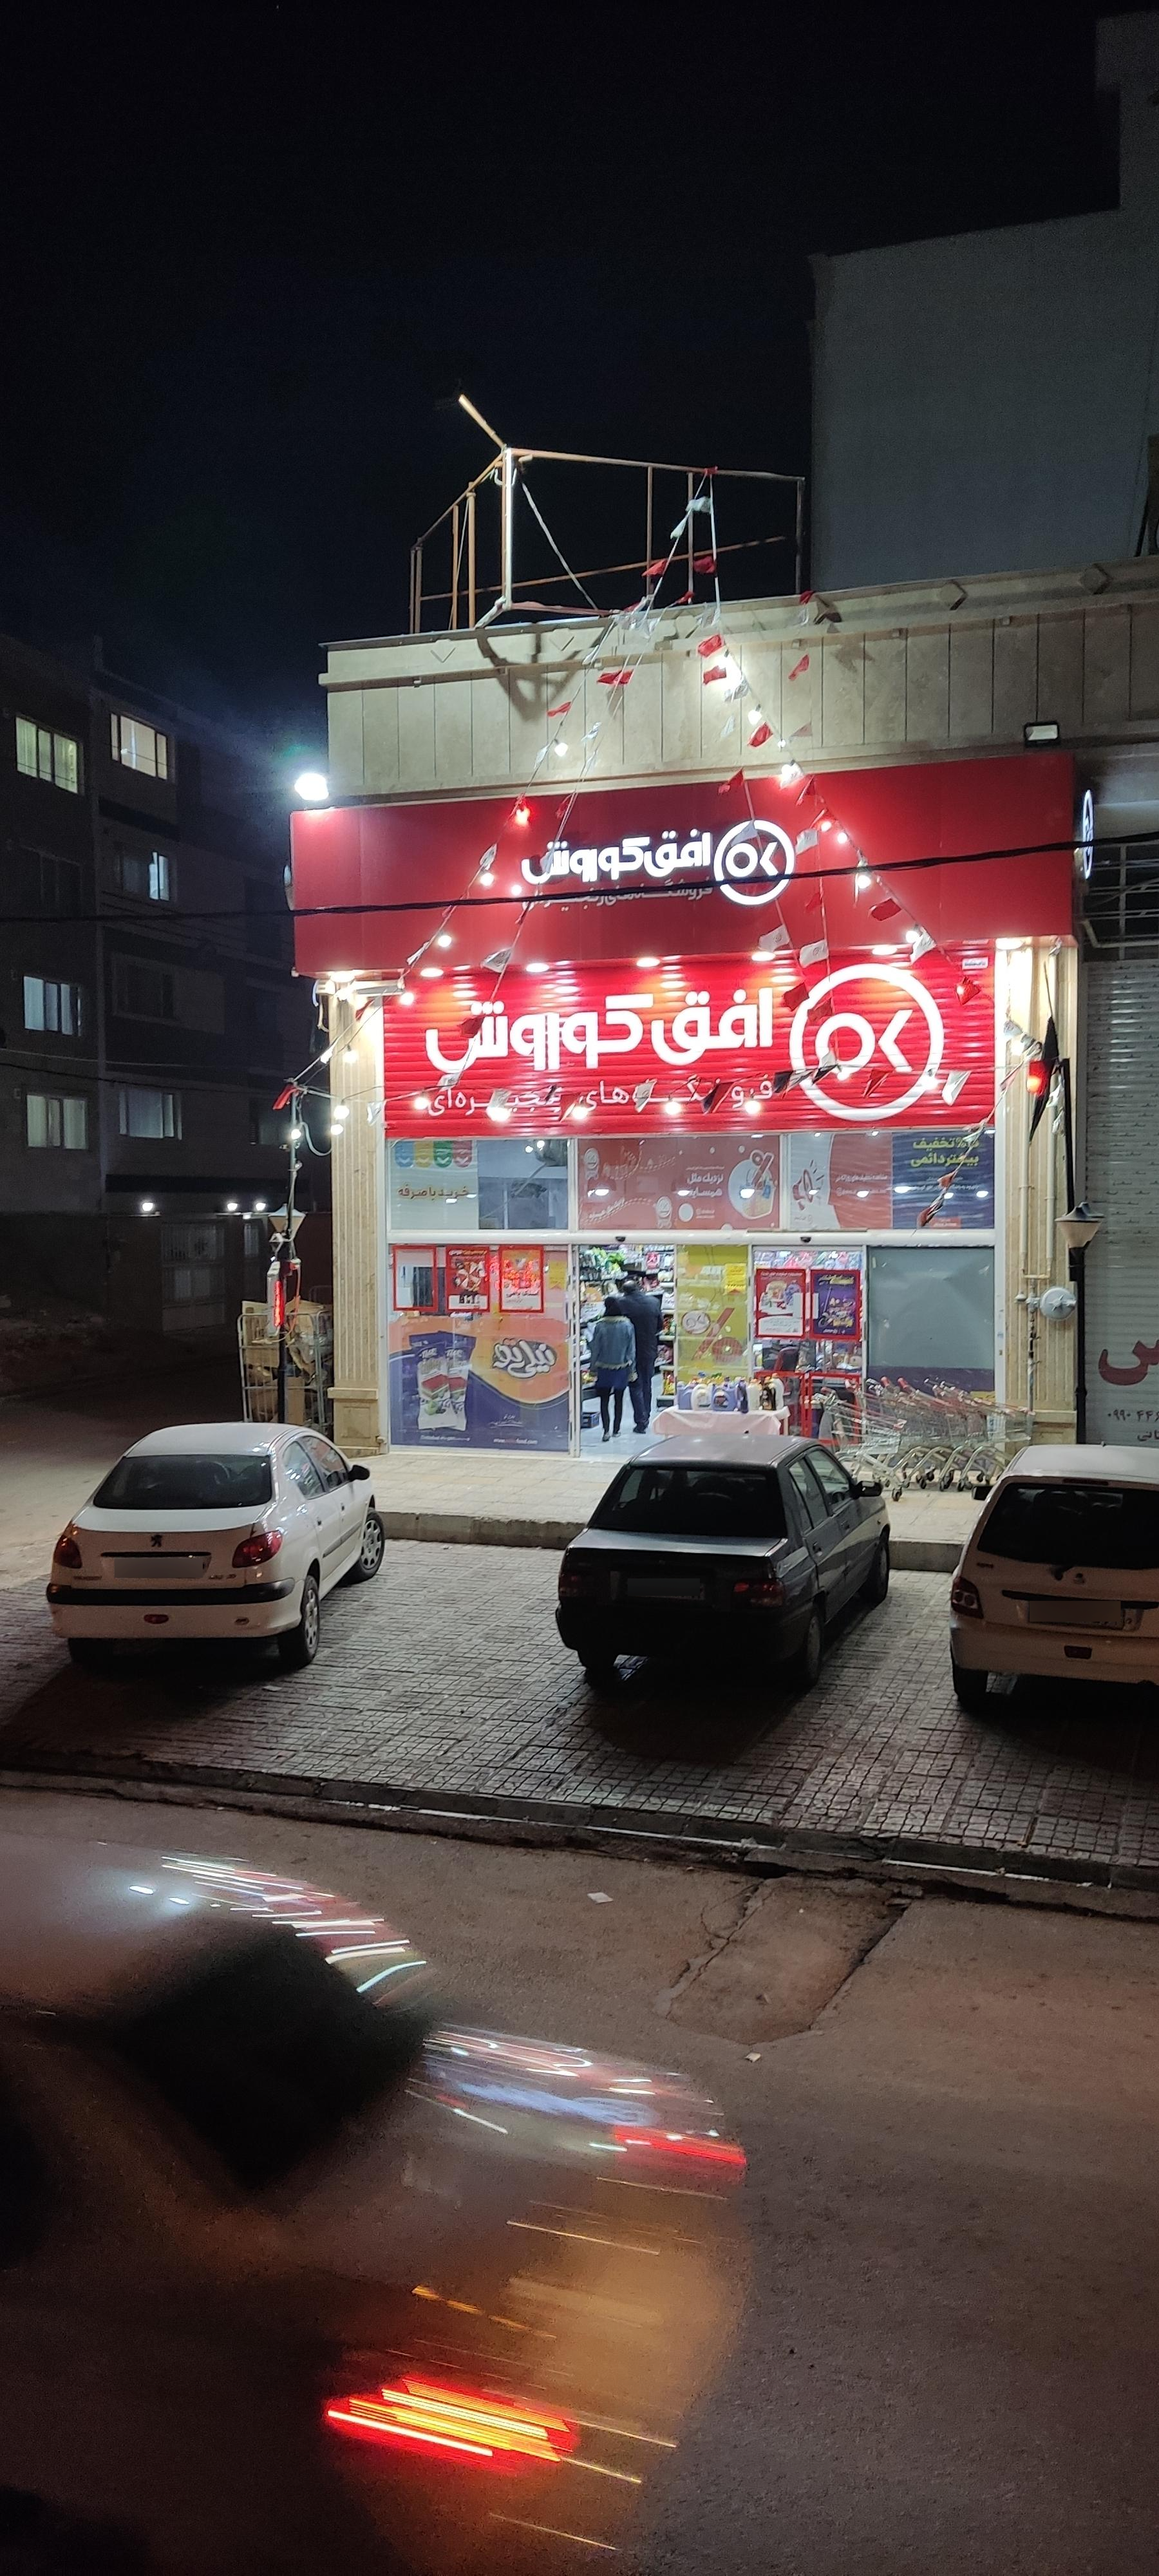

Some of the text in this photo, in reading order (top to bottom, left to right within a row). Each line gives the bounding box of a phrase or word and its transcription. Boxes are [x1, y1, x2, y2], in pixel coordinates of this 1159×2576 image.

[521, 828, 712, 884] افق کوروش
[426, 988, 773, 1074] افق کوروش
[815, 1009, 913, 1074] OK
[910, 1152, 979, 1167] بیتر دائمی
[913, 1137, 955, 1151] تخفیف
[1137, 1430, 1159, 1441] انی
